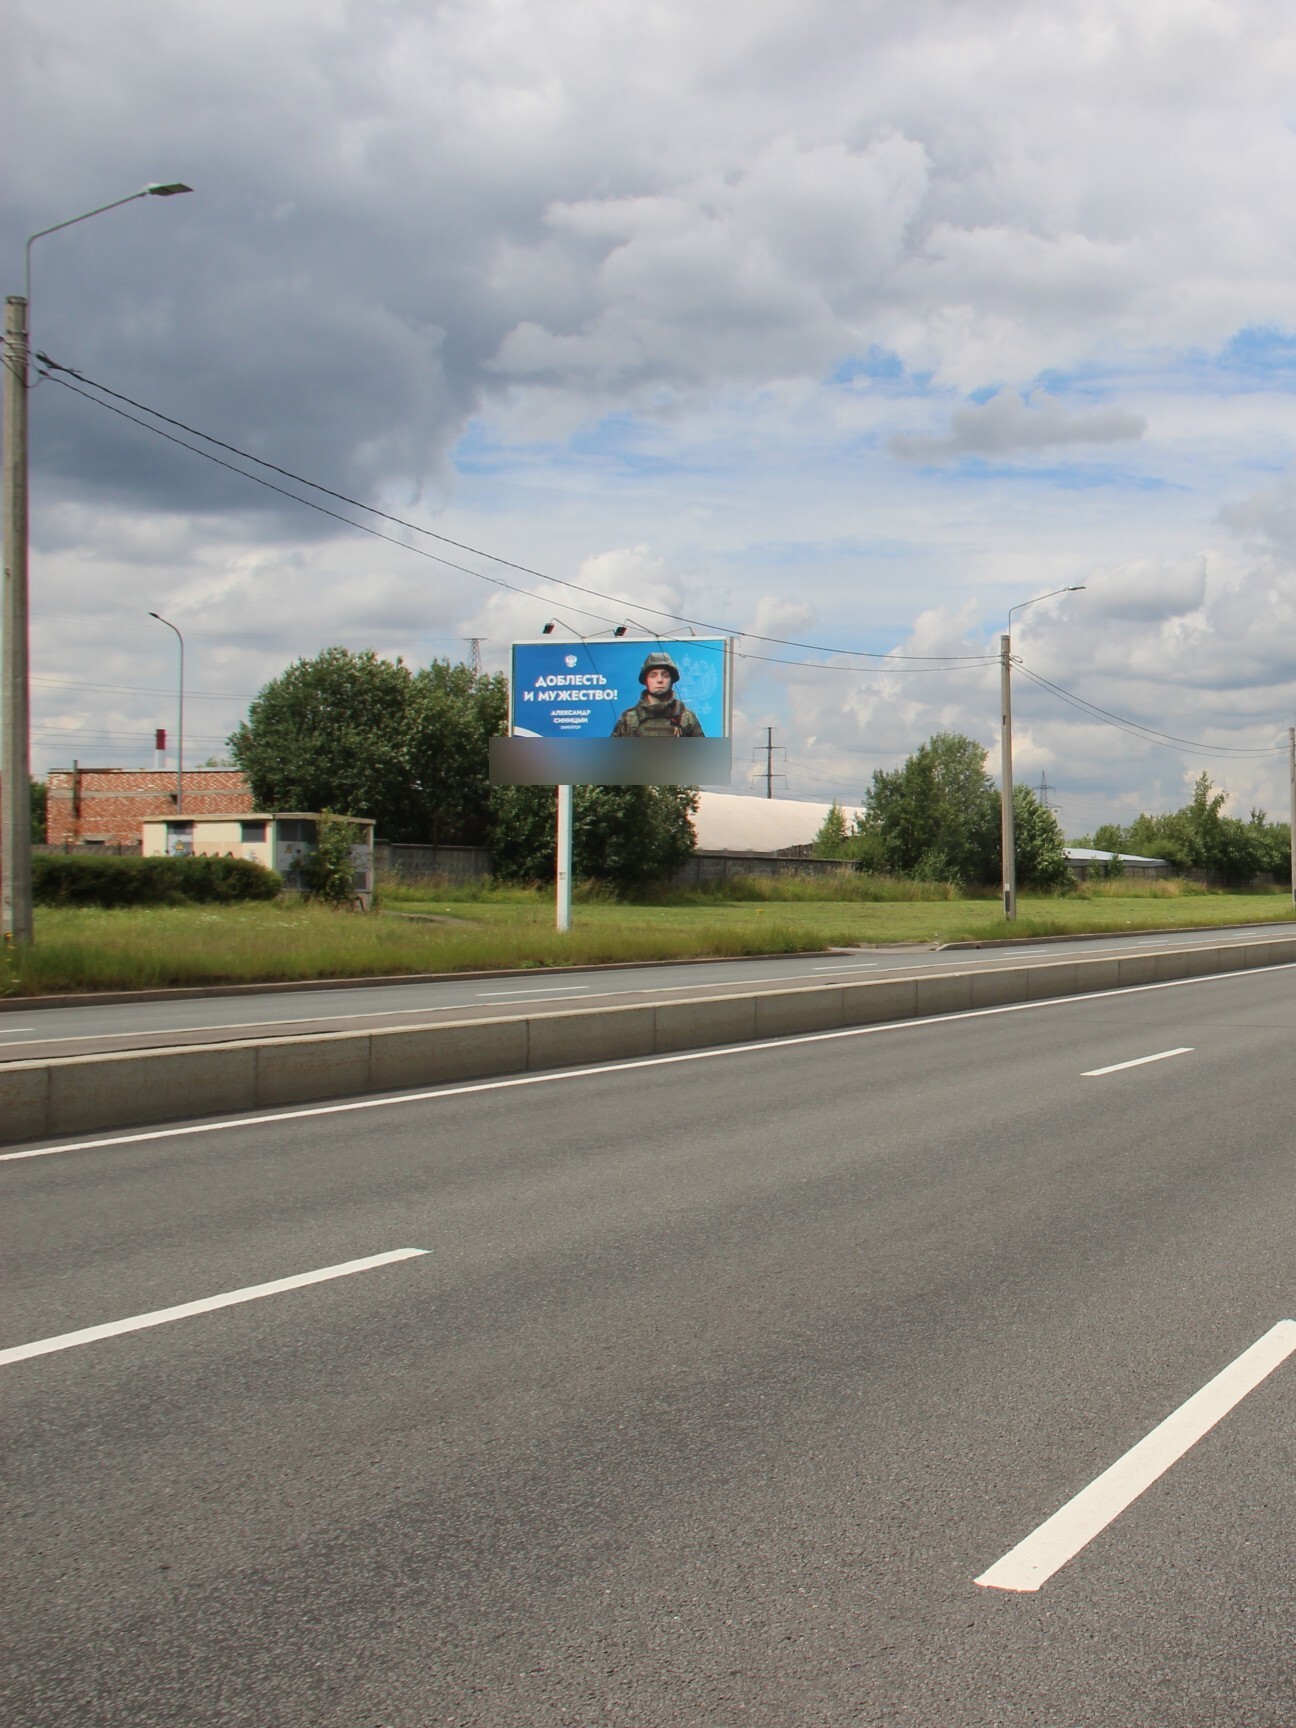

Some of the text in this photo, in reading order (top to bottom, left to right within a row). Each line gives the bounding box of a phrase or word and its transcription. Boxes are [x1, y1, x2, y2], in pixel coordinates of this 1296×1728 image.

[535, 674, 607, 688] ДОБЛЕСТЬ
[524, 690, 618, 701] И МУЖЕСТВО!
